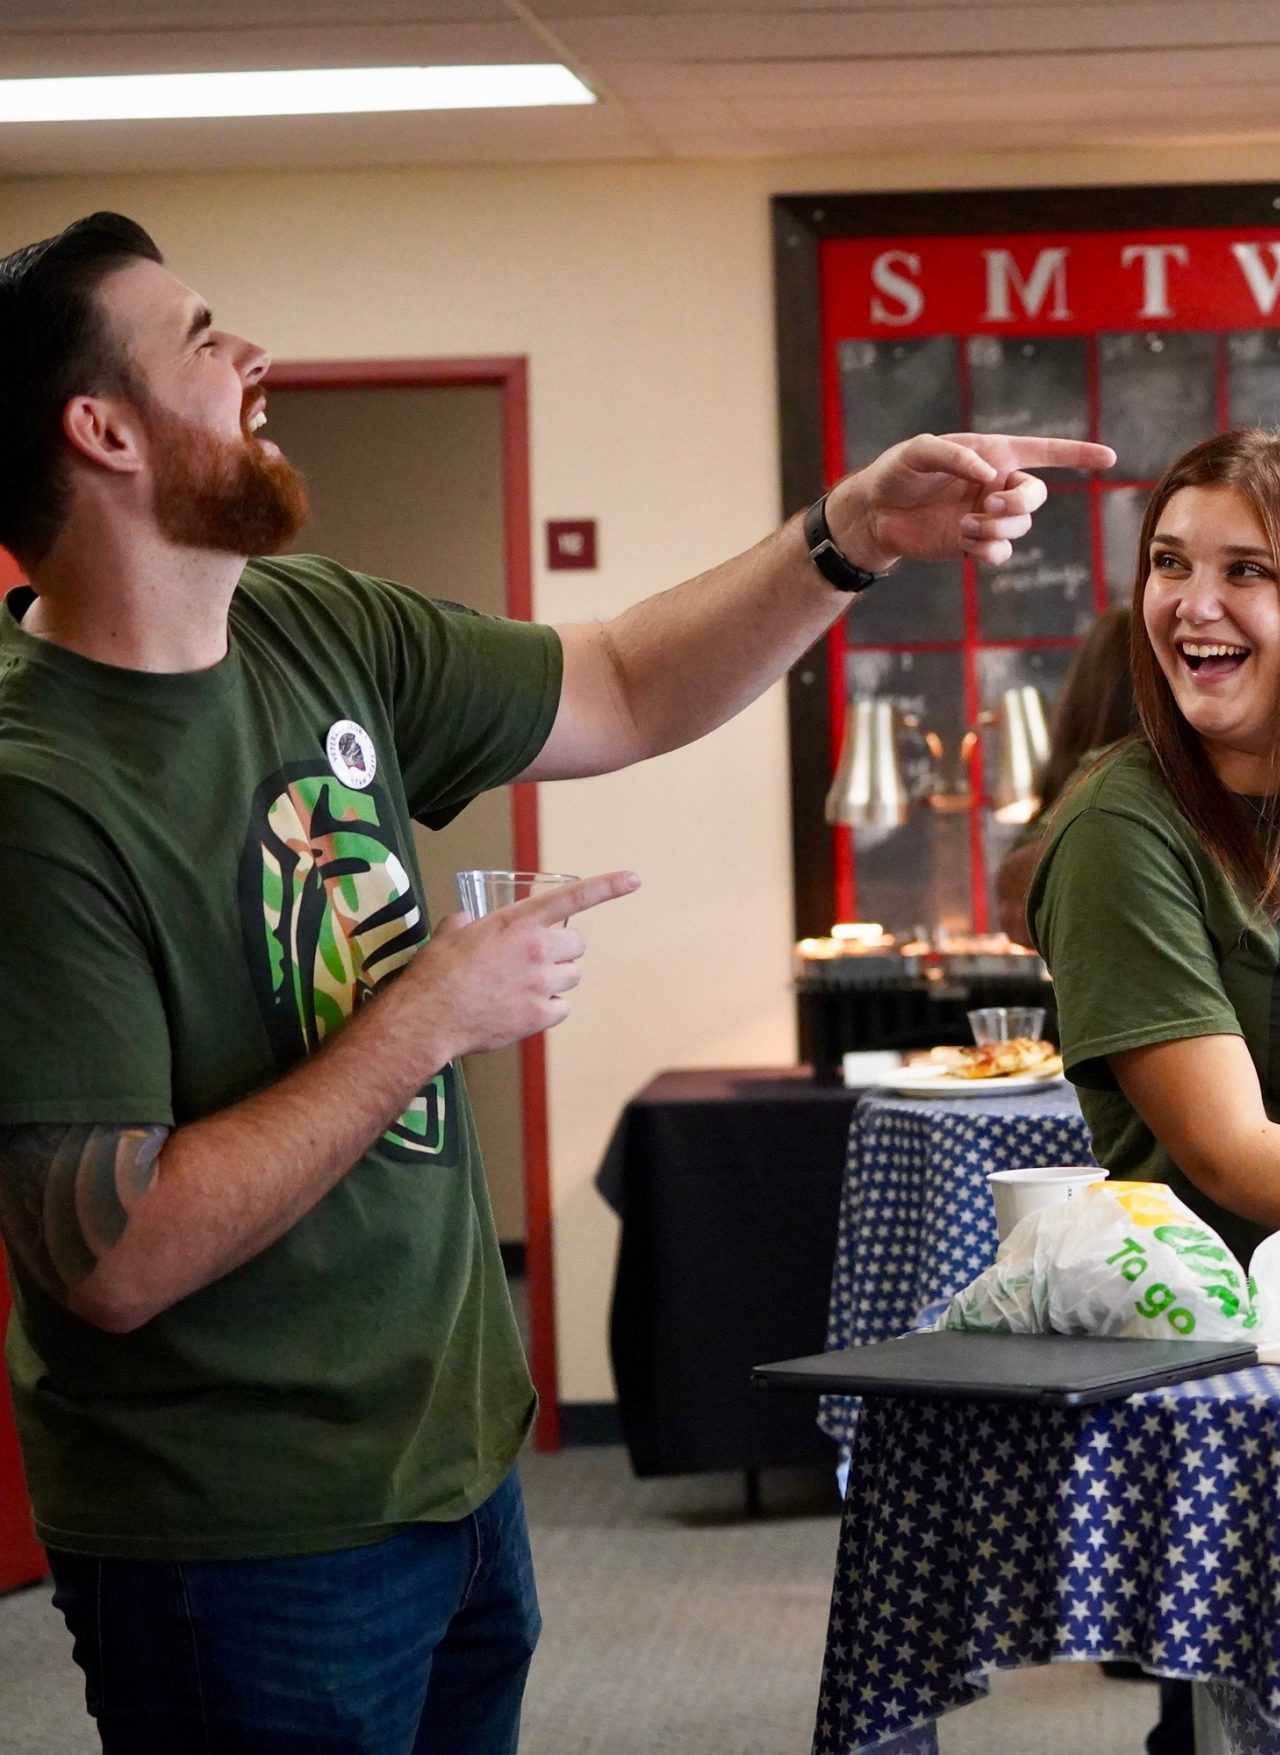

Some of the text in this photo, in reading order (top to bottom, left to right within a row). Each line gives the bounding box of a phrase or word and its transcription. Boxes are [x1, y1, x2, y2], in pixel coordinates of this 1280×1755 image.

[870, 251, 925, 325] S
[983, 248, 1070, 321] M
[1121, 244, 1189, 318] T
[1105, 1237, 1148, 1282] To
[1135, 1282, 1196, 1335] go
